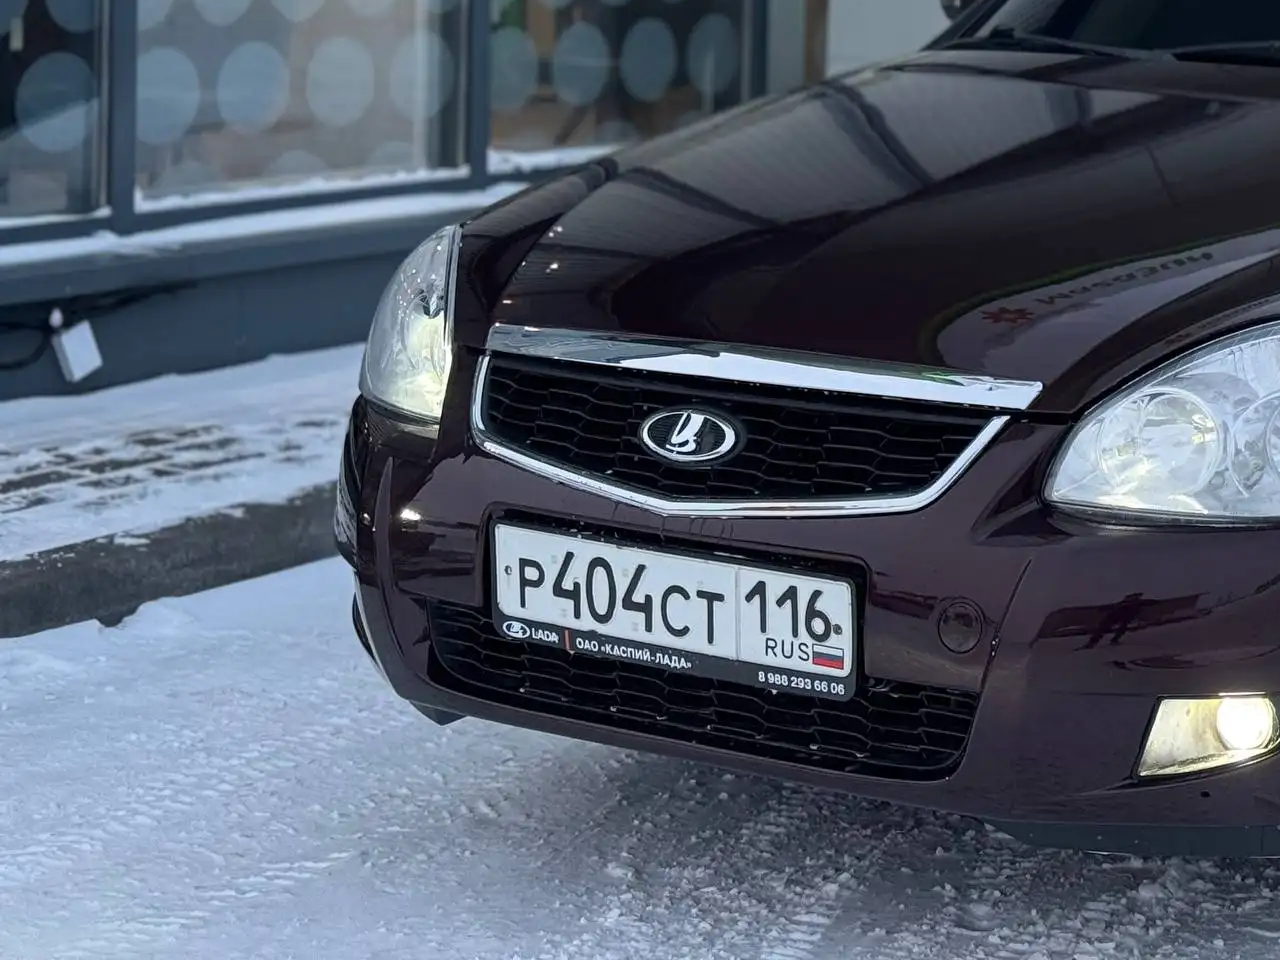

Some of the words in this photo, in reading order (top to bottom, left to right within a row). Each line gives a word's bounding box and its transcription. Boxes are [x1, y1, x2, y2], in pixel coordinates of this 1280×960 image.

[517, 551, 725, 645] Р404СТ
[744, 580, 833, 642] 116
[531, 627, 560, 644] LADA
[575, 637, 599, 653] ОАО
[600, 642, 693, 670] «КАСПИЙ-ЛАДА»
[765, 637, 810, 662] RUS
[758, 670, 767, 683] 8
[767, 672, 789, 687] 988
[790, 675, 812, 690] 293
[813, 679, 829, 693] 66
[830, 681, 846, 696] 06
